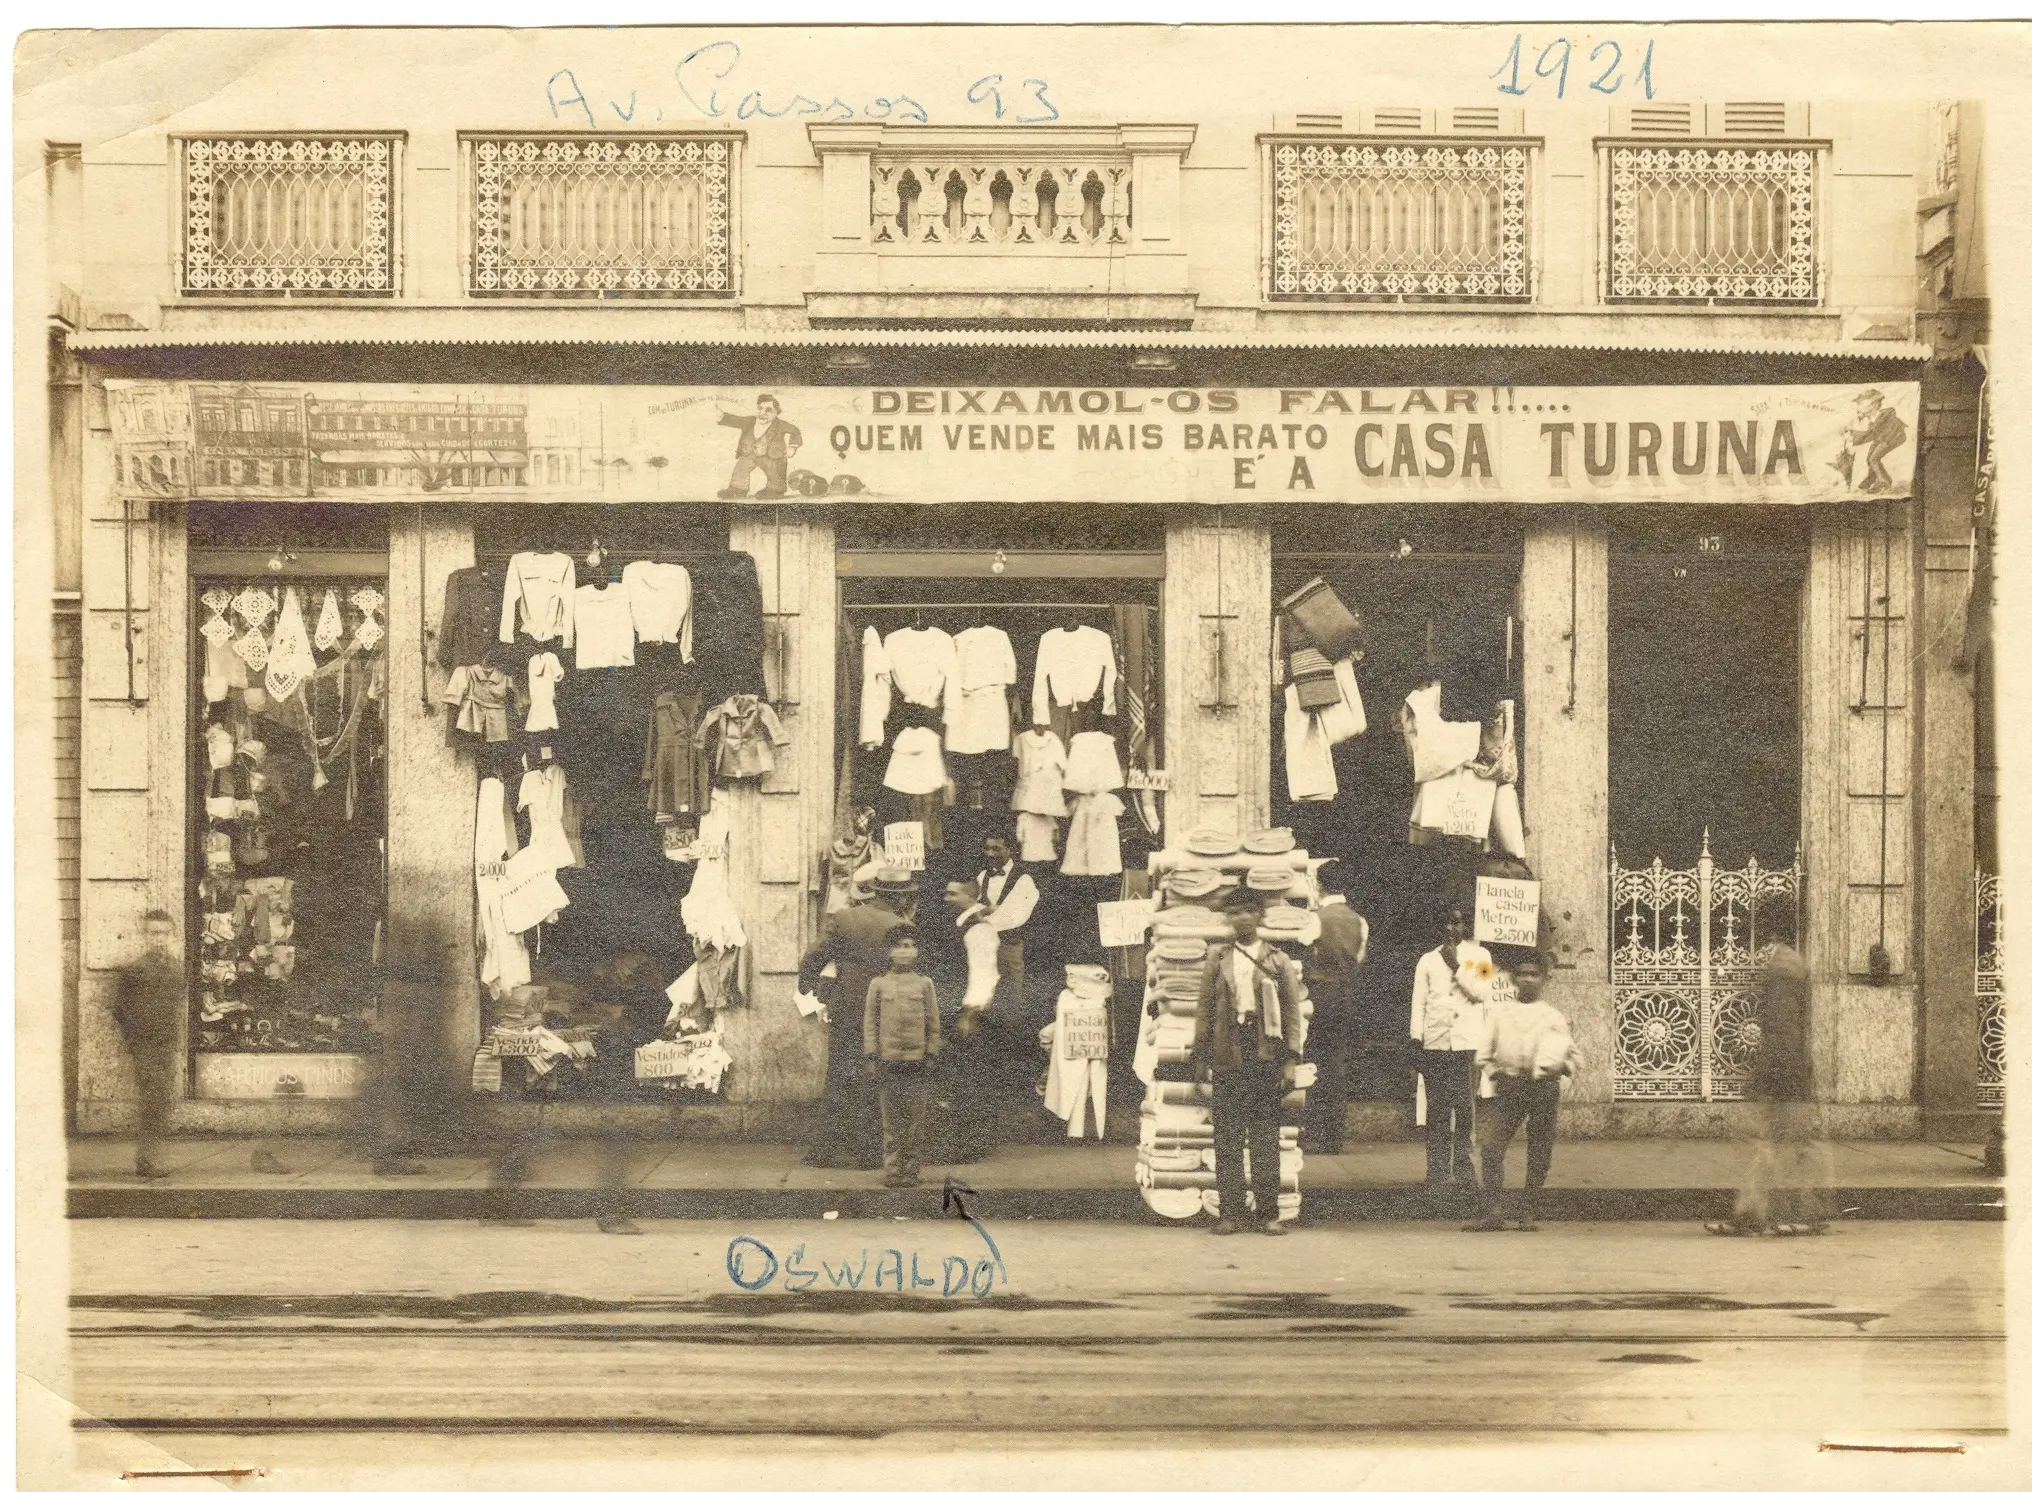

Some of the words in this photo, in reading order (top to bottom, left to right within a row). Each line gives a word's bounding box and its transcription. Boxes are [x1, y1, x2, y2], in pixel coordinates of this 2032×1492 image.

[1488, 33, 1657, 100] 1921
[967, 74, 1060, 122] 93
[872, 390, 1239, 414] DEIXAMOL-OS
[830, 423, 923, 459] QUEM
[943, 424, 1055, 451] VENDE
[1077, 424, 1163, 451] MAIS
[1183, 423, 1328, 450] BARATO
[1354, 422, 1494, 479] CASA
[1540, 419, 1803, 477] TURUNA
[1287, 455, 1316, 489] A
[1478, 883, 1525, 899] Flanela
[1495, 899, 1537, 913] castor
[727, 1235, 995, 1299] OSWALDO
